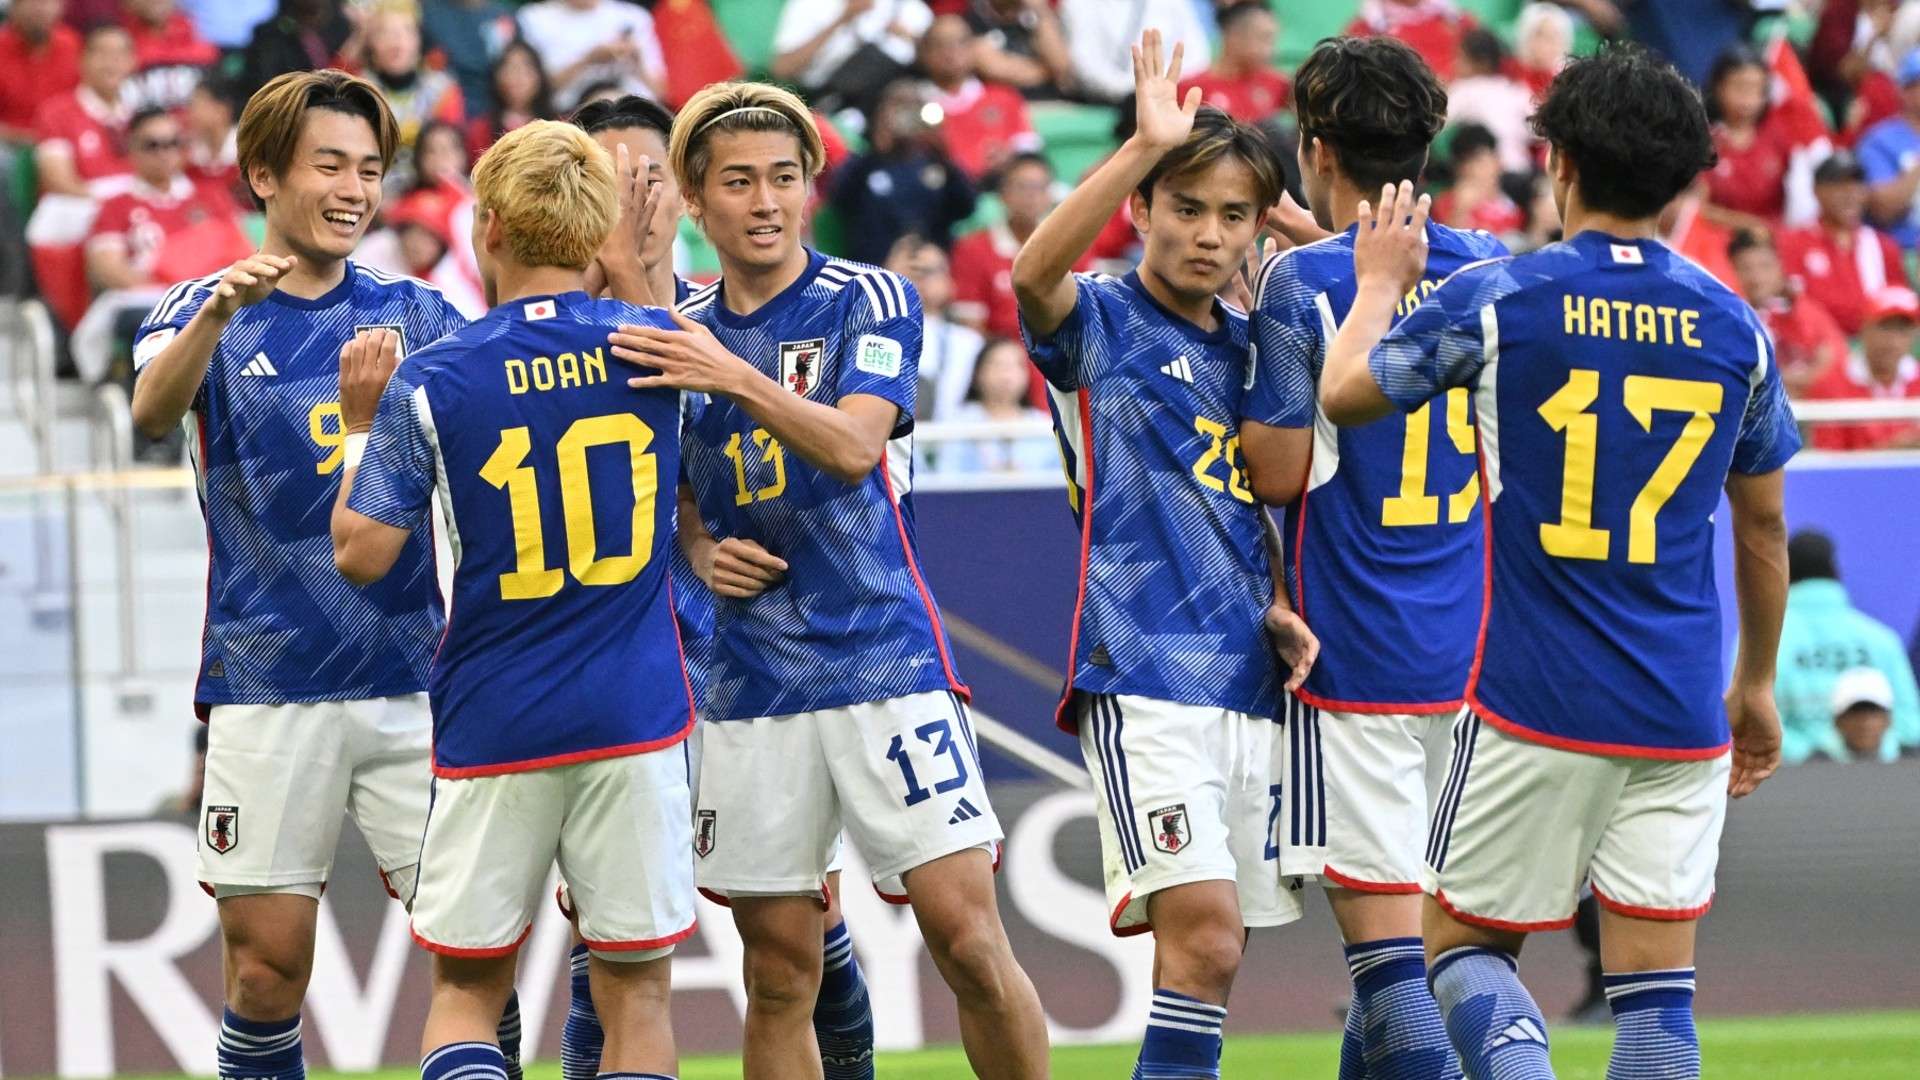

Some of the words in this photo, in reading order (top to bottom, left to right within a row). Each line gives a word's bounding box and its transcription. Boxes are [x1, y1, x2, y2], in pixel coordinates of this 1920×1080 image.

[792, 341, 815, 351] JAPAN
[866, 341, 885, 350] AFC
[1564, 294, 1702, 348] HATATE
[504, 346, 608, 395] DOAN
[864, 347, 896, 362] LIVE
[308, 401, 349, 475] 9
[723, 427, 787, 507] 13
[1536, 368, 1724, 564] 17
[478, 412, 658, 600] 10
[886, 718, 968, 807] 13
